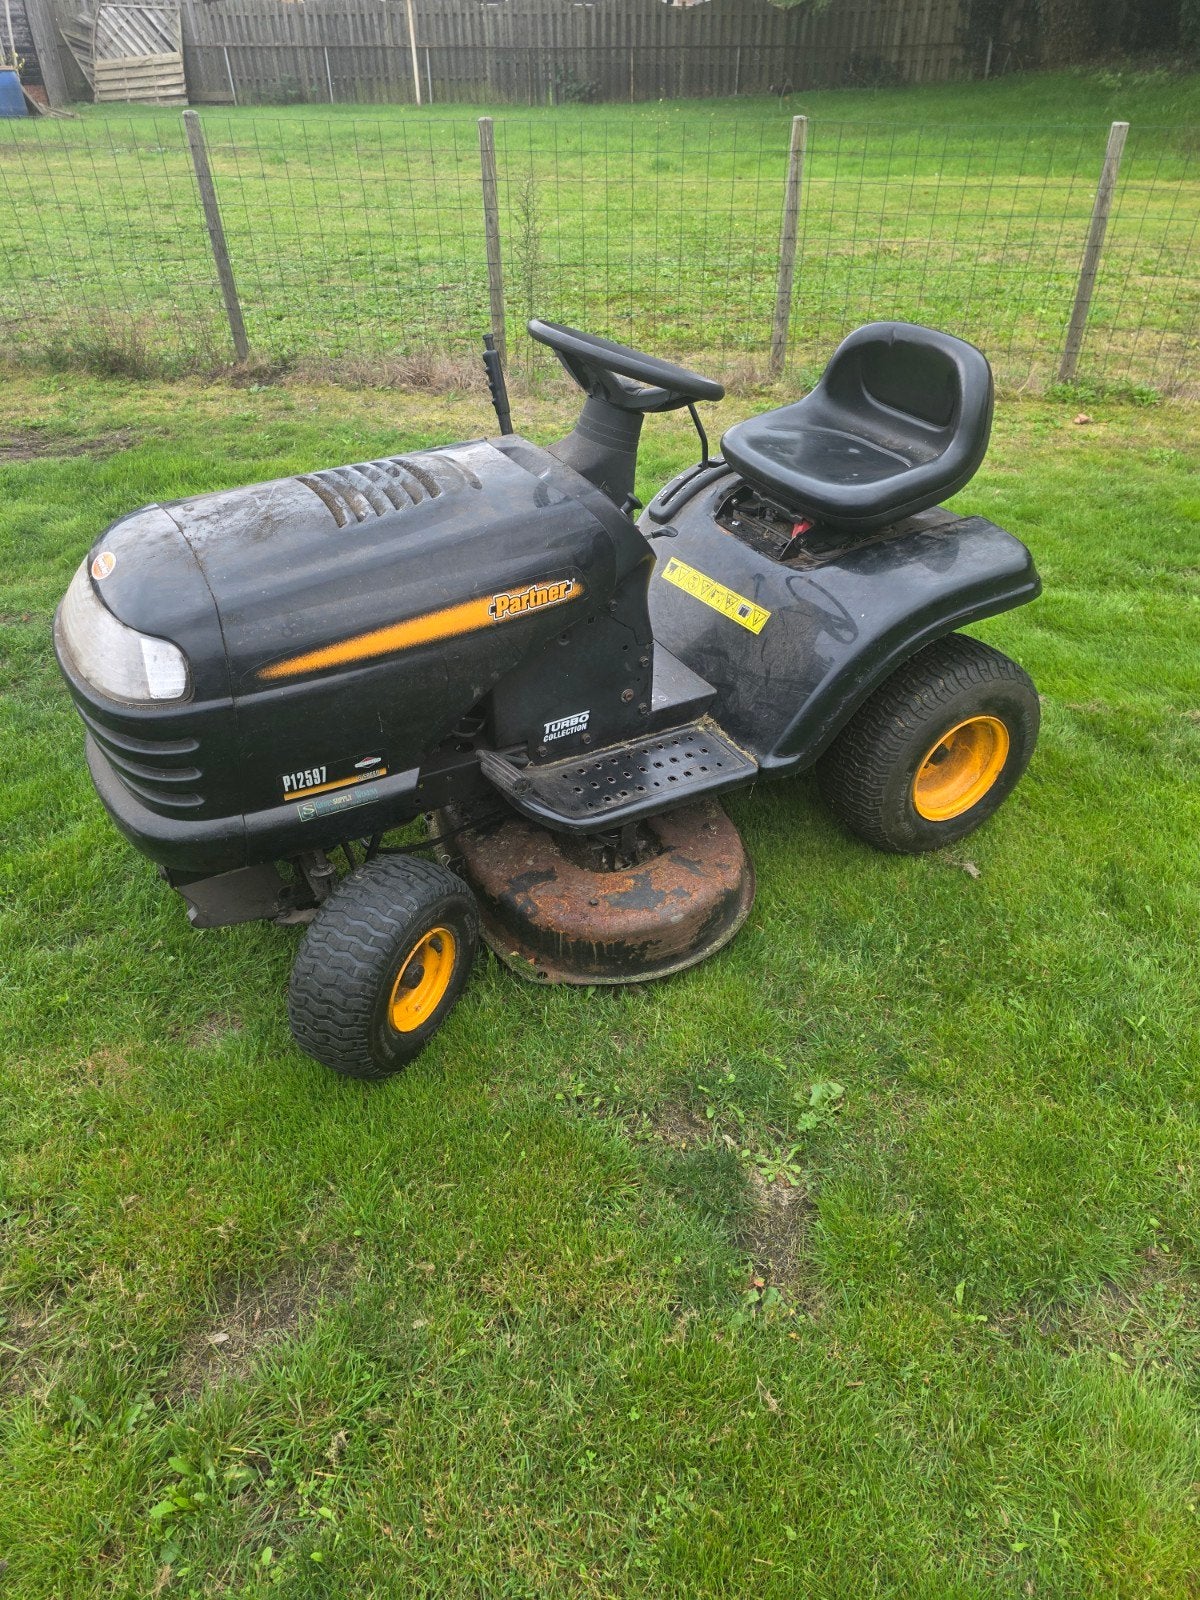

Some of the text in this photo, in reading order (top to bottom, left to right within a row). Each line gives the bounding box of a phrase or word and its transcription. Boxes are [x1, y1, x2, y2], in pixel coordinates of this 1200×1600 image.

[490, 580, 573, 619] Partner
[543, 710, 590, 734] TURBO
[543, 723, 587, 742] COLLECTION
[282, 766, 327, 792] P12597
